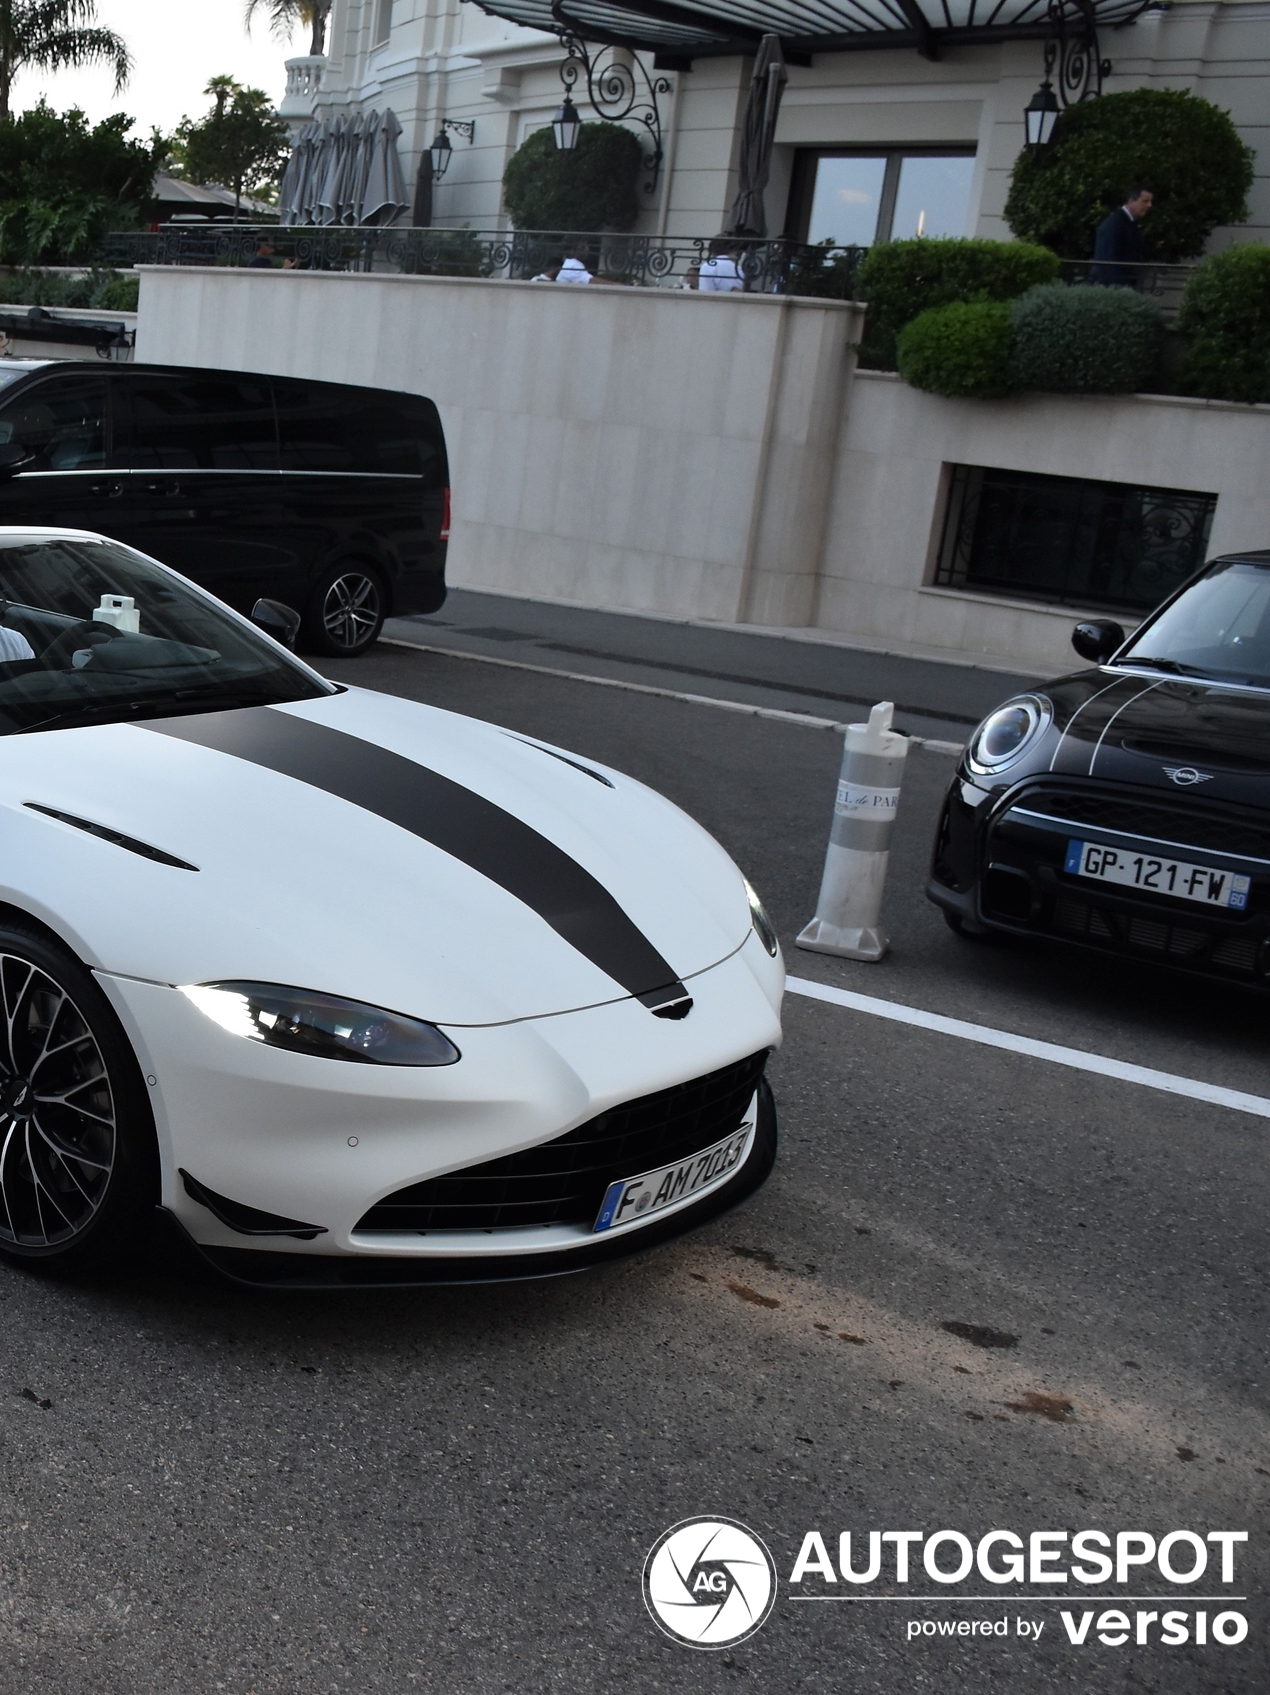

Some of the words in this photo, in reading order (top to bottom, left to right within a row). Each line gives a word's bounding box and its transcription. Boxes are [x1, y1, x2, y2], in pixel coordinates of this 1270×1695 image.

[836, 788, 852, 804] EL
[1084, 847, 1226, 901] GP-121-FW
[602, 1211, 610, 1222] D
[615, 1181, 644, 1219] F
